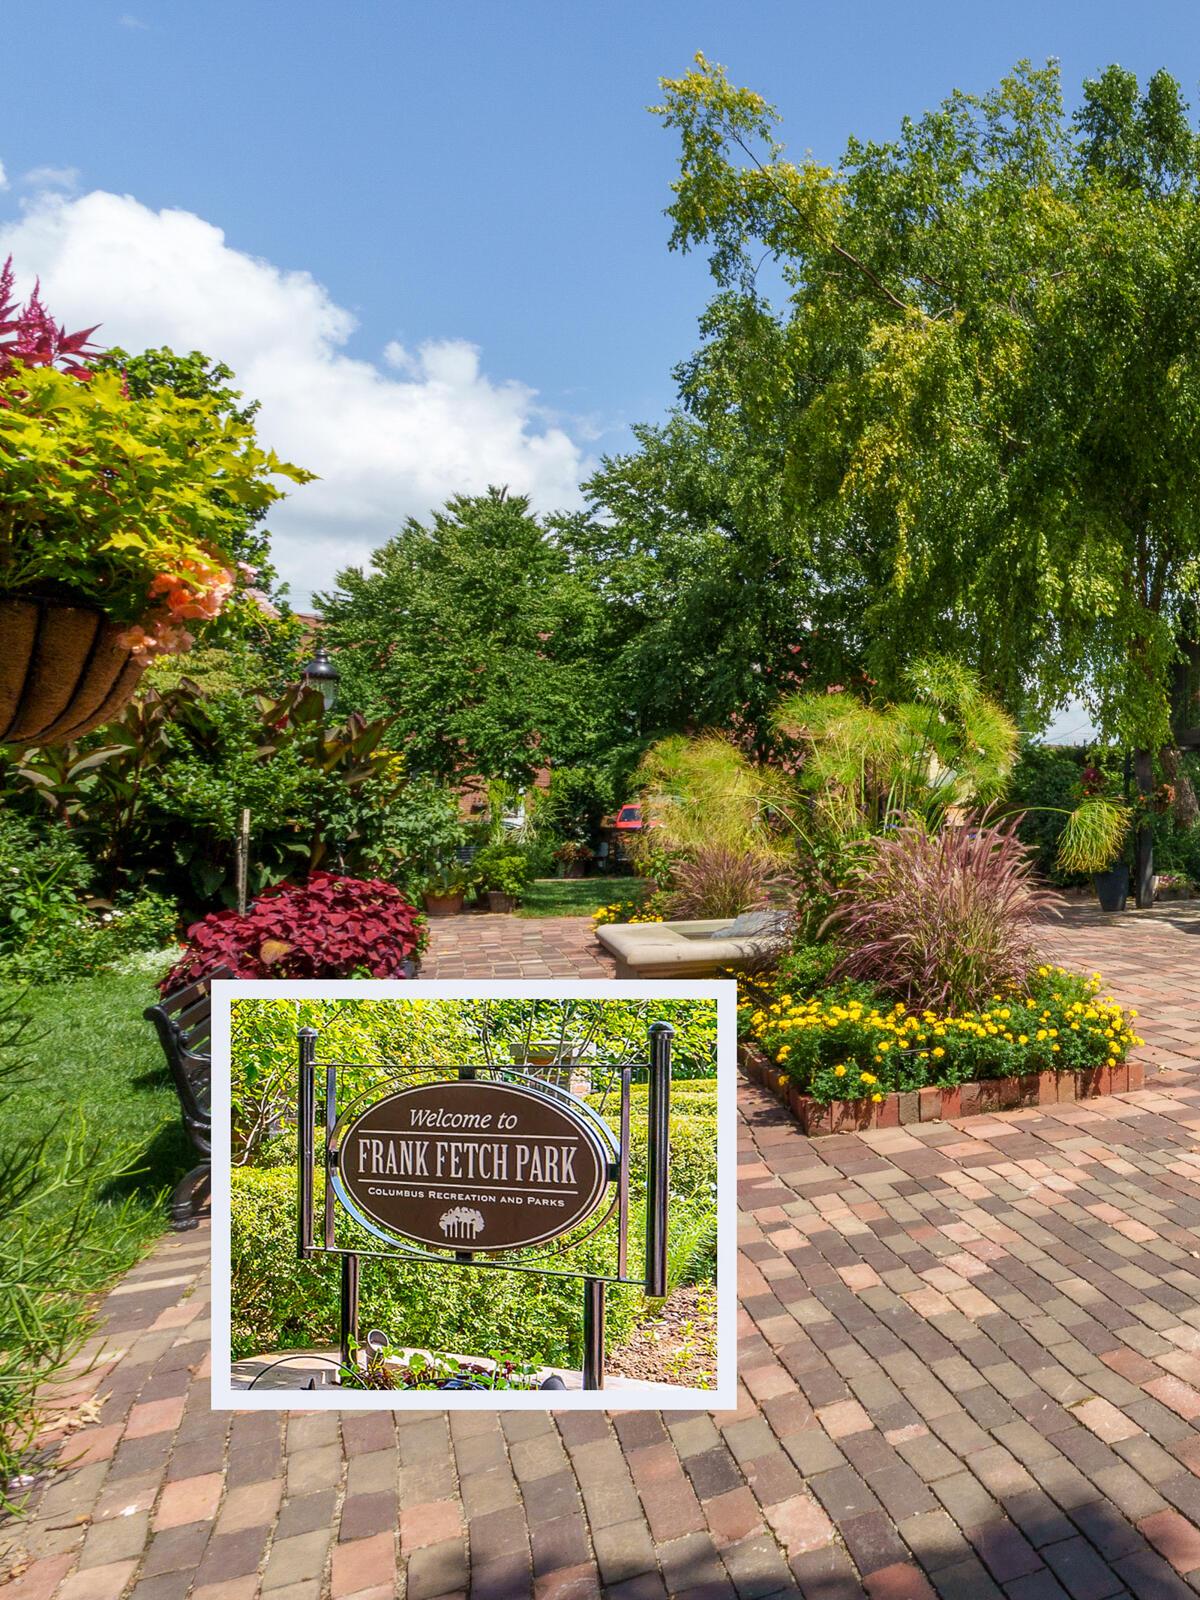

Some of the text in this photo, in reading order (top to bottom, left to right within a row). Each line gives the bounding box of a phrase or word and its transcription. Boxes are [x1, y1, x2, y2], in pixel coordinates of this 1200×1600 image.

[410, 1108, 518, 1130] Welcome to
[358, 1139, 578, 1184] FRANK FETCH PARK
[368, 1187, 565, 1207] COLUMBUS RECREATION AND PARKS
